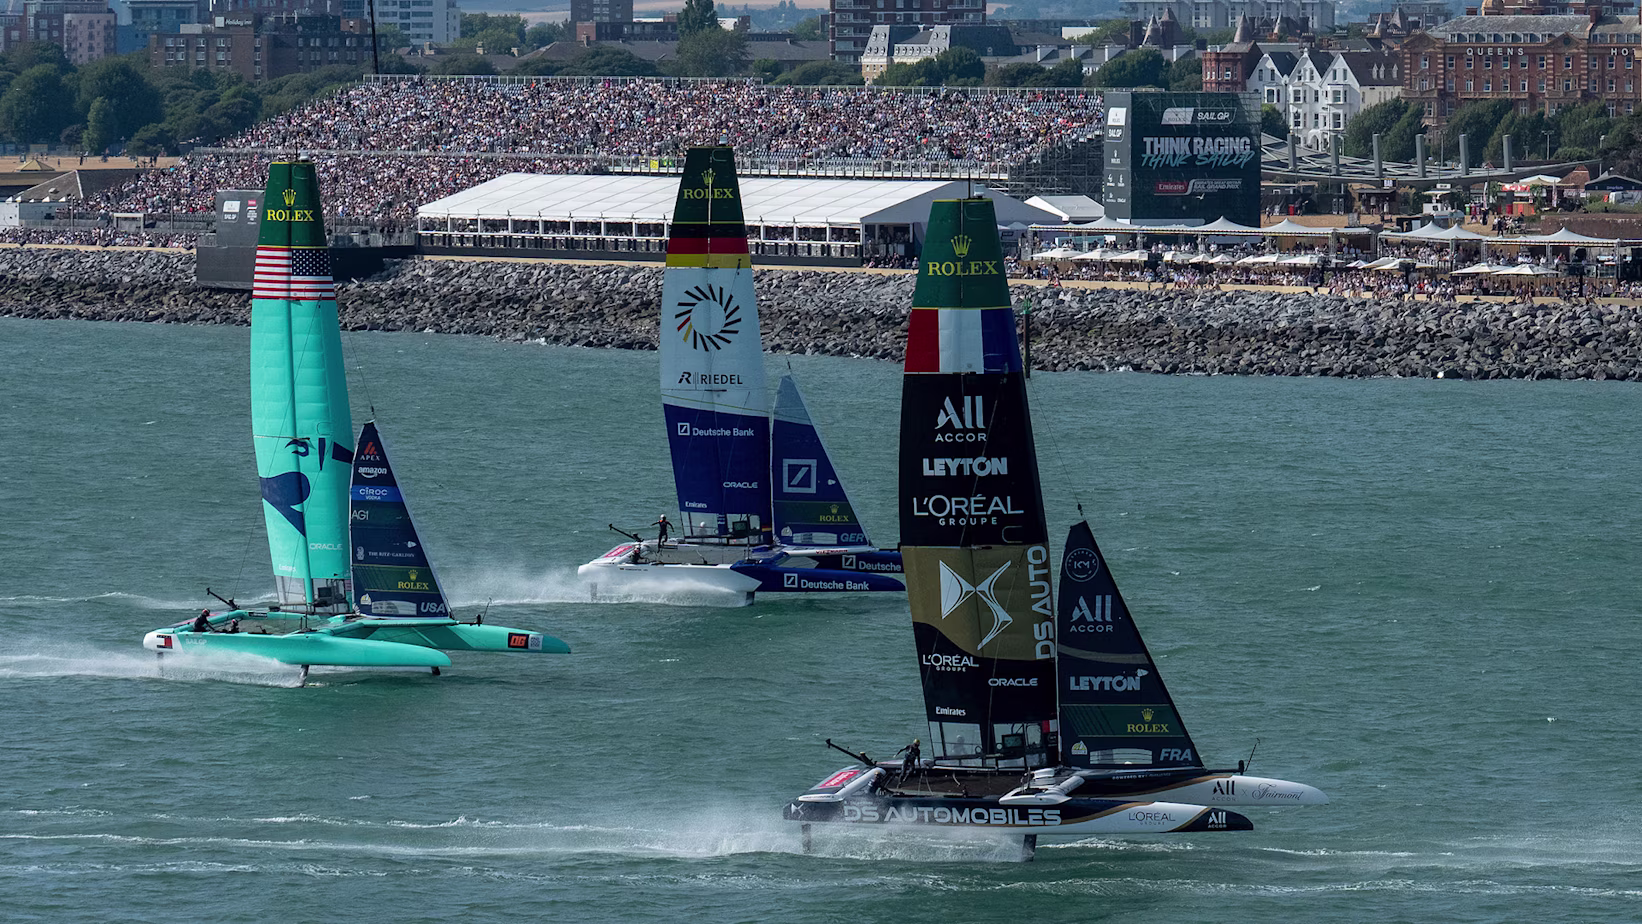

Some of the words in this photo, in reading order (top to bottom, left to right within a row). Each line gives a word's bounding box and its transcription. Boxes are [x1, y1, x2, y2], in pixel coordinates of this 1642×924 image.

[1466, 47, 1525, 56] QUEENS
[1143, 137, 1191, 155] THINK
[1193, 136, 1251, 155] RACING
[1141, 153, 1192, 170] THINK
[683, 188, 734, 199] ROLEX
[266, 209, 315, 222] ROLEX
[927, 261, 999, 277] ROLEX
[700, 374, 744, 385] RIEDEL
[692, 427, 731, 437] Deutsche
[732, 427, 755, 437] Bank
[934, 432, 987, 443] ACCOR
[358, 466, 387, 475] amazon
[723, 481, 759, 489] ORACLE
[939, 517, 998, 526] GROUPE
[840, 533, 865, 543] GER
[309, 543, 343, 551] ORACLE
[859, 561, 902, 572] Deutsche
[397, 581, 429, 590] ROLEX
[801, 579, 844, 590] Deutsche
[846, 581, 870, 591] Bank
[1027, 545, 1052, 616] AUTO
[420, 602, 446, 613] USA
[1070, 624, 1114, 633] ACCOR
[1034, 621, 1055, 660] DS
[988, 678, 1038, 687] ORACLE
[935, 706, 966, 717] Emirates
[1127, 723, 1169, 733] ROLEX
[1160, 748, 1192, 761] FRA
[1251, 782, 1304, 801] Fairmont
[844, 805, 880, 822] DS
[884, 806, 1062, 826] AUTOMOBILES
